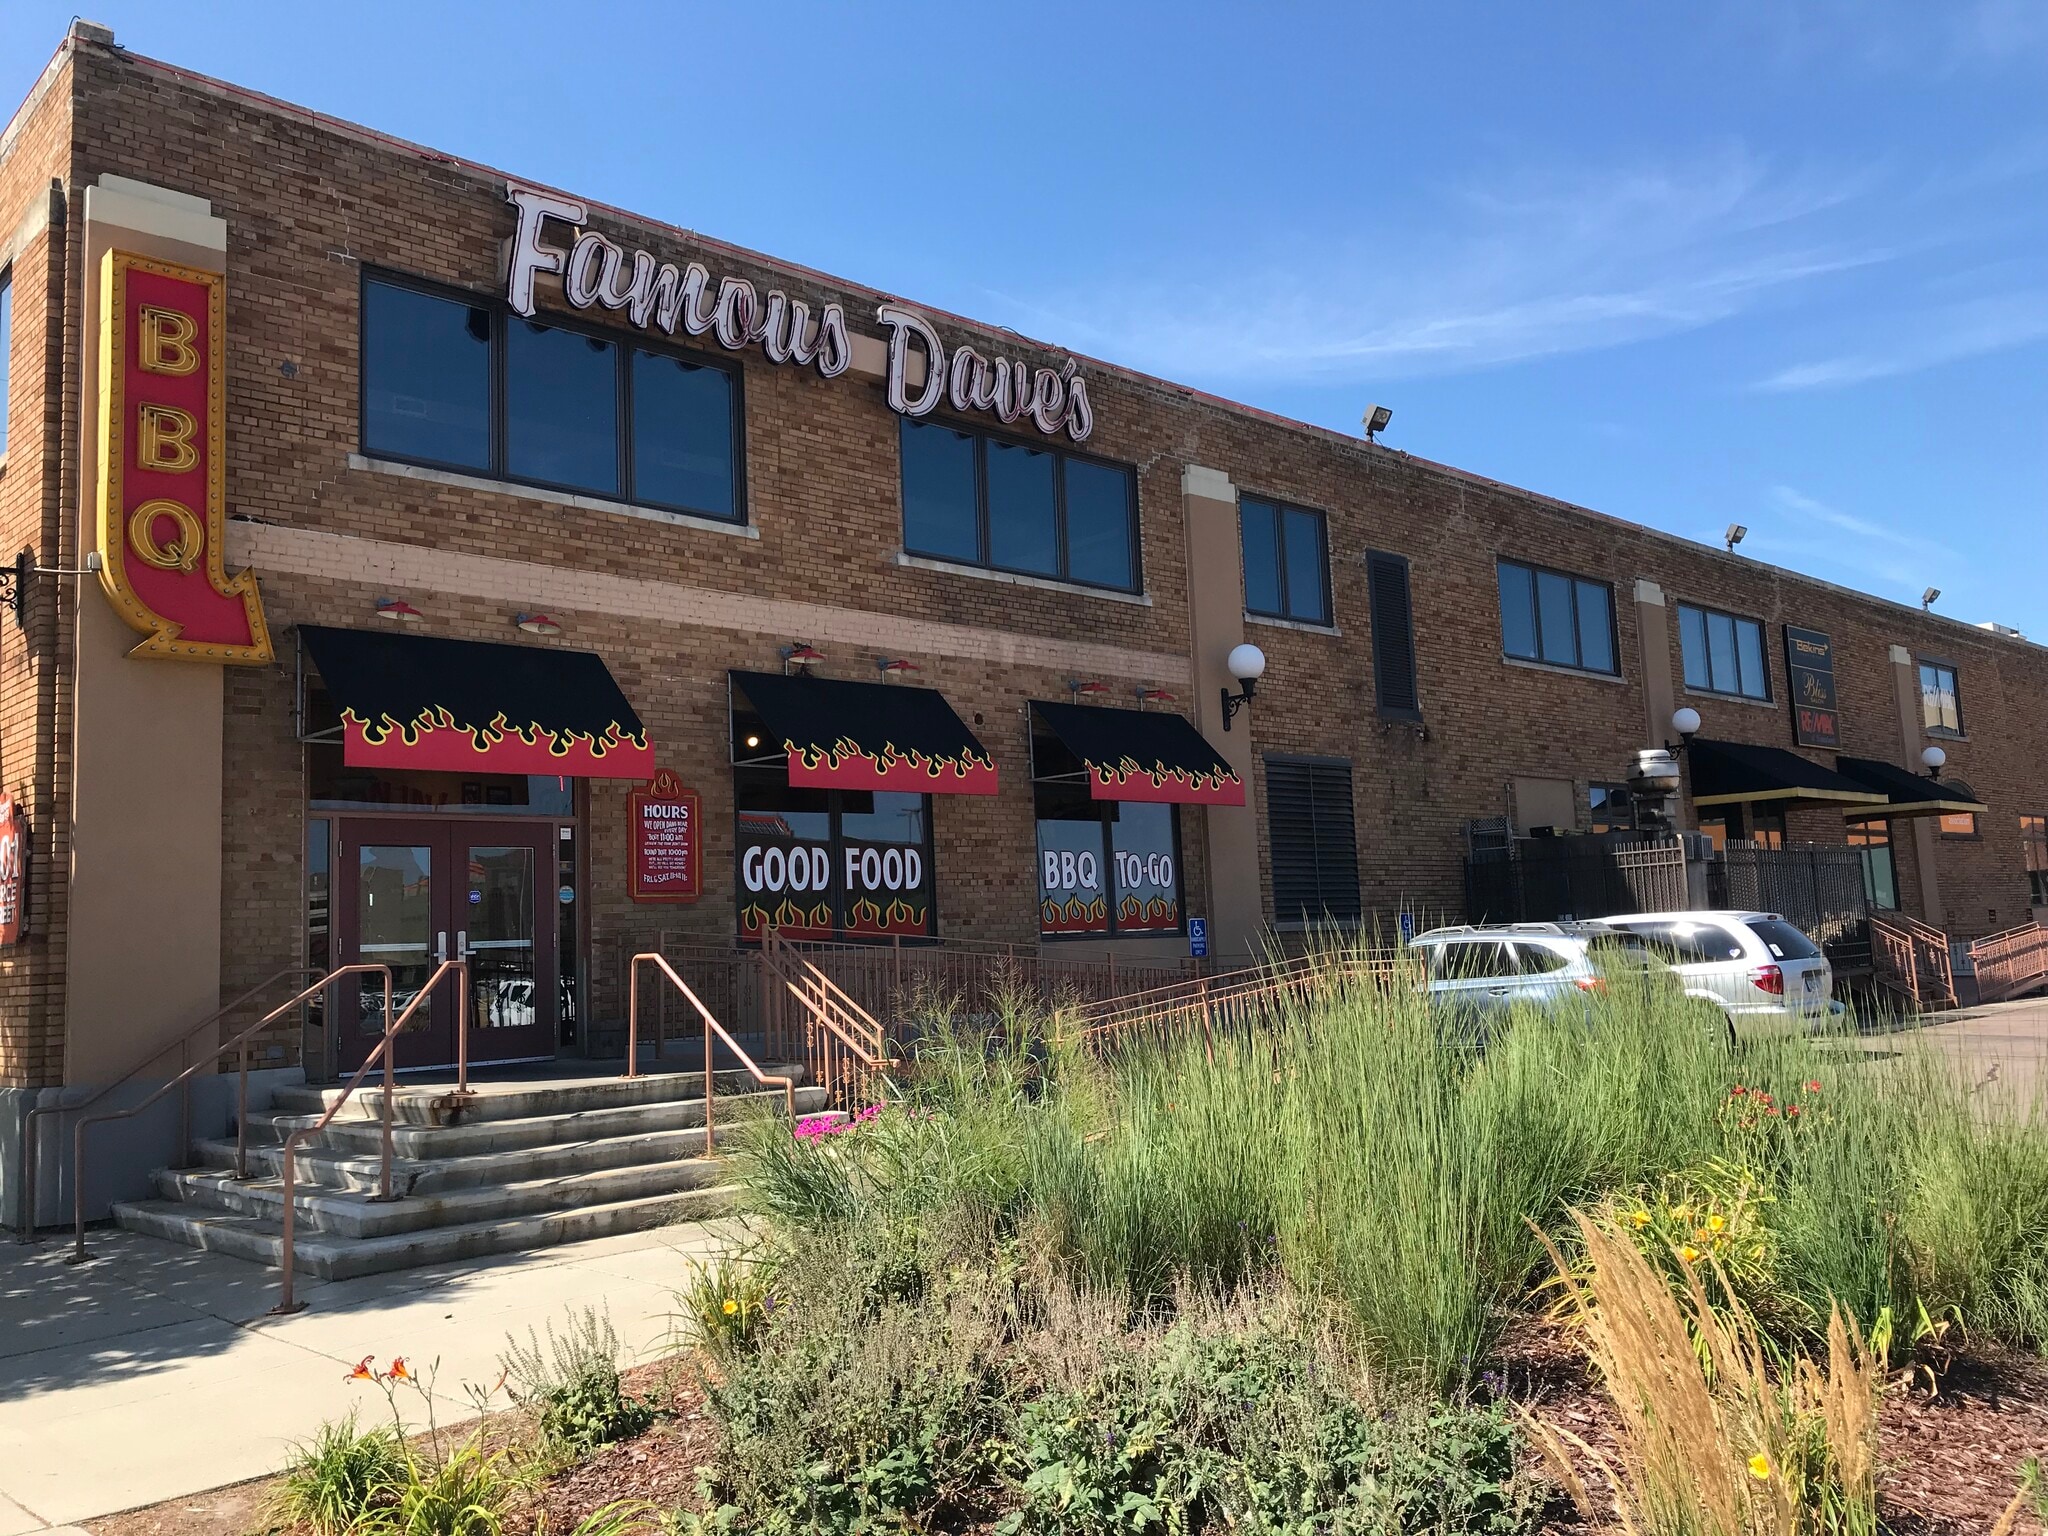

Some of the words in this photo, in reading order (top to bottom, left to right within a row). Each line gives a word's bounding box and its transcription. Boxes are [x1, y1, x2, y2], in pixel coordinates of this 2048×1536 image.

[505, 180, 853, 379] Famous
[876, 303, 1094, 444] Dave's
[128, 302, 205, 577] BBQ
[643, 804, 689, 819] HOURS
[742, 845, 830, 893] GOOD
[845, 846, 922, 892] FOOD
[1043, 850, 1099, 891] BBQ
[1115, 850, 1174, 890] TO-GO
